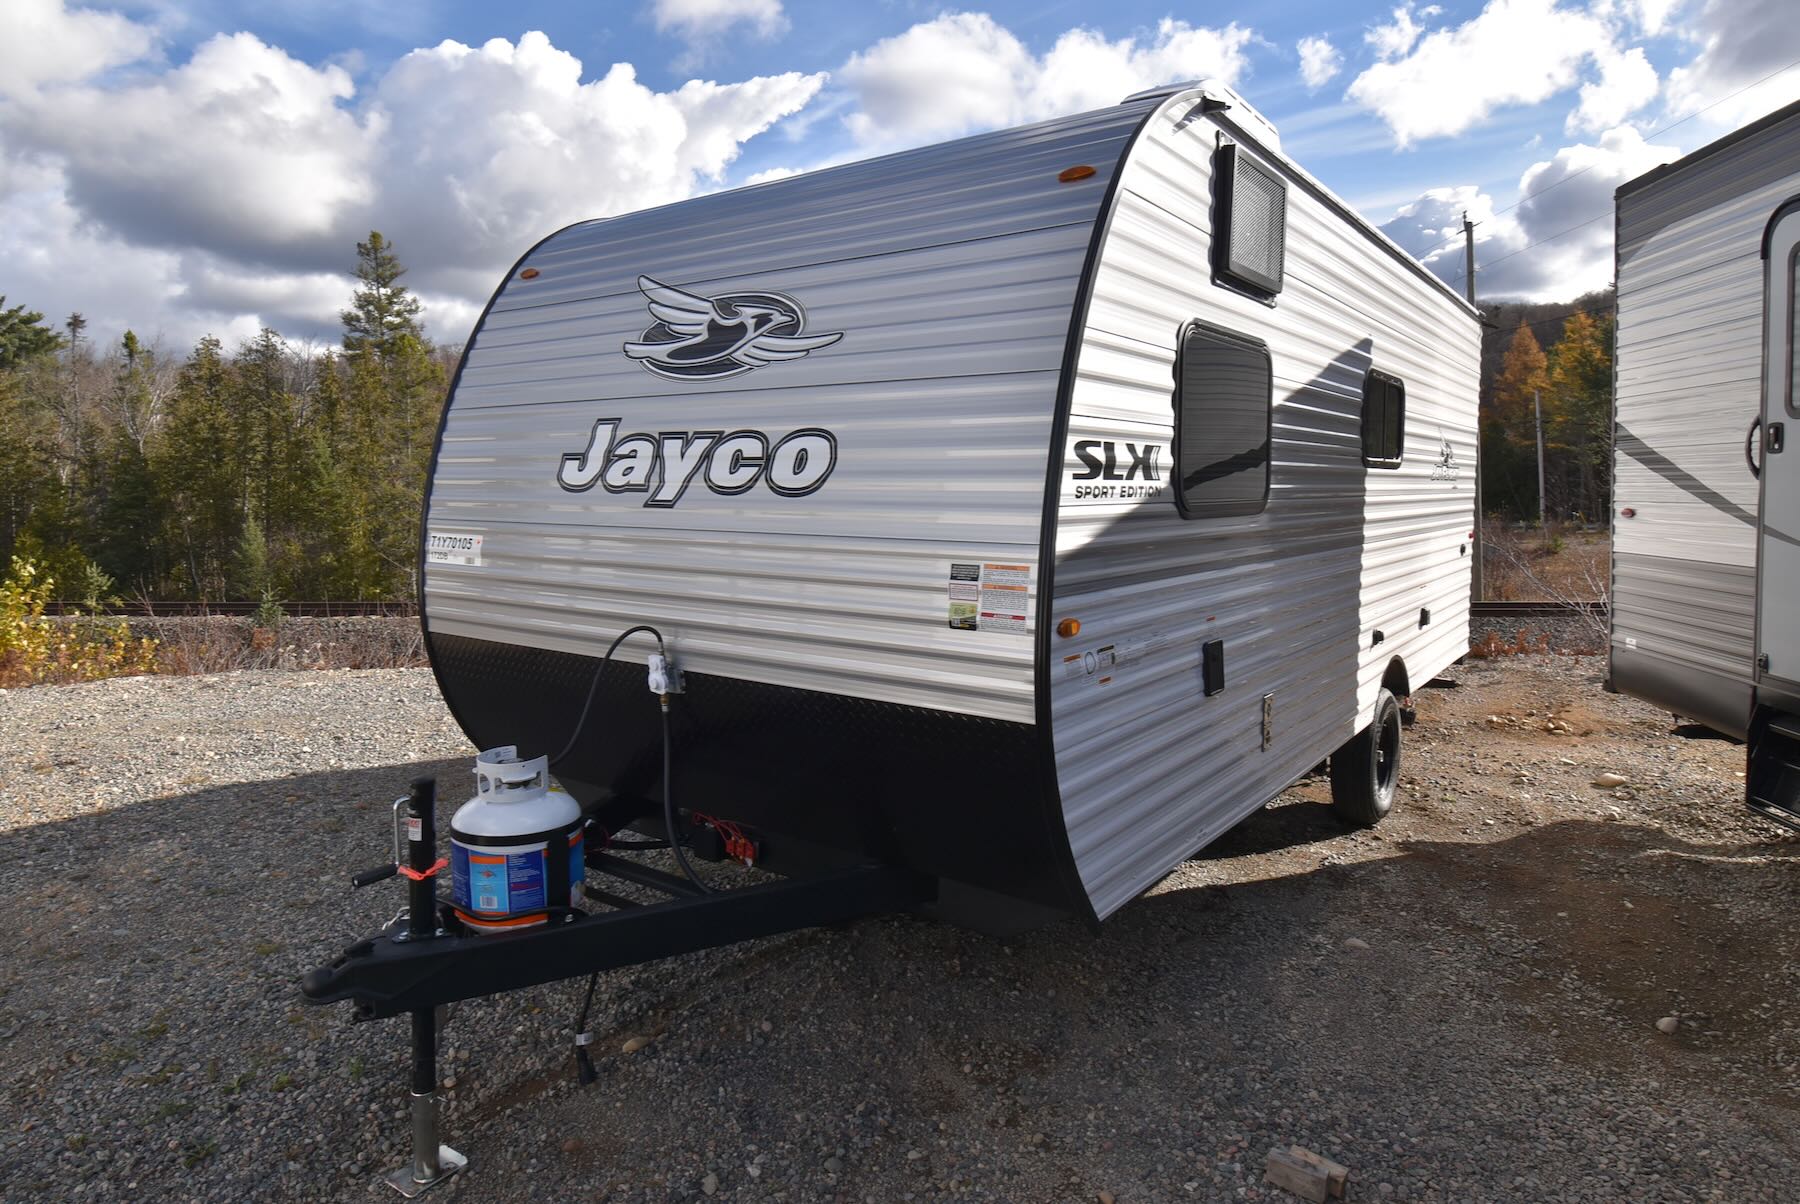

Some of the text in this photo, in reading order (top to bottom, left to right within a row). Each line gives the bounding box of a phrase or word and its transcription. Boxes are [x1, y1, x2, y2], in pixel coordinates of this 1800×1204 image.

[557, 418, 838, 508] Jayco
[1072, 440, 1161, 481] SLX
[1075, 485, 1161, 499] SPORT EDITION
